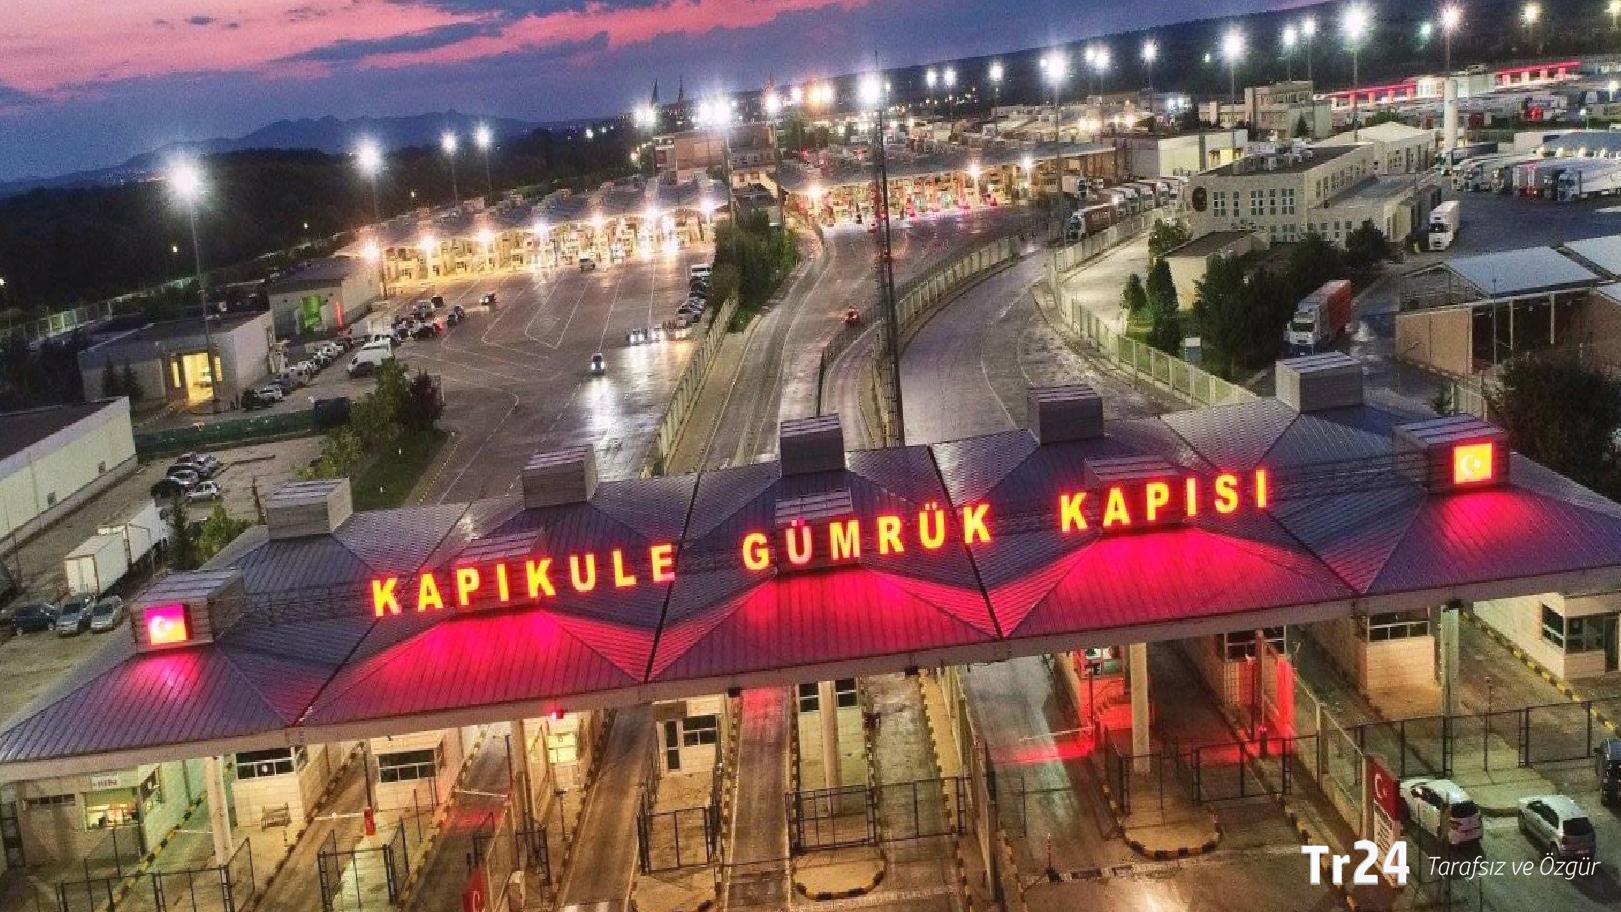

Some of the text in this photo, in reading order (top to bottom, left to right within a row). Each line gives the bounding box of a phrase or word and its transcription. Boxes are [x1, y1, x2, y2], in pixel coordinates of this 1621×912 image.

[371, 469, 1268, 617] KAPIKULE GÜMRÜK KAPISI
